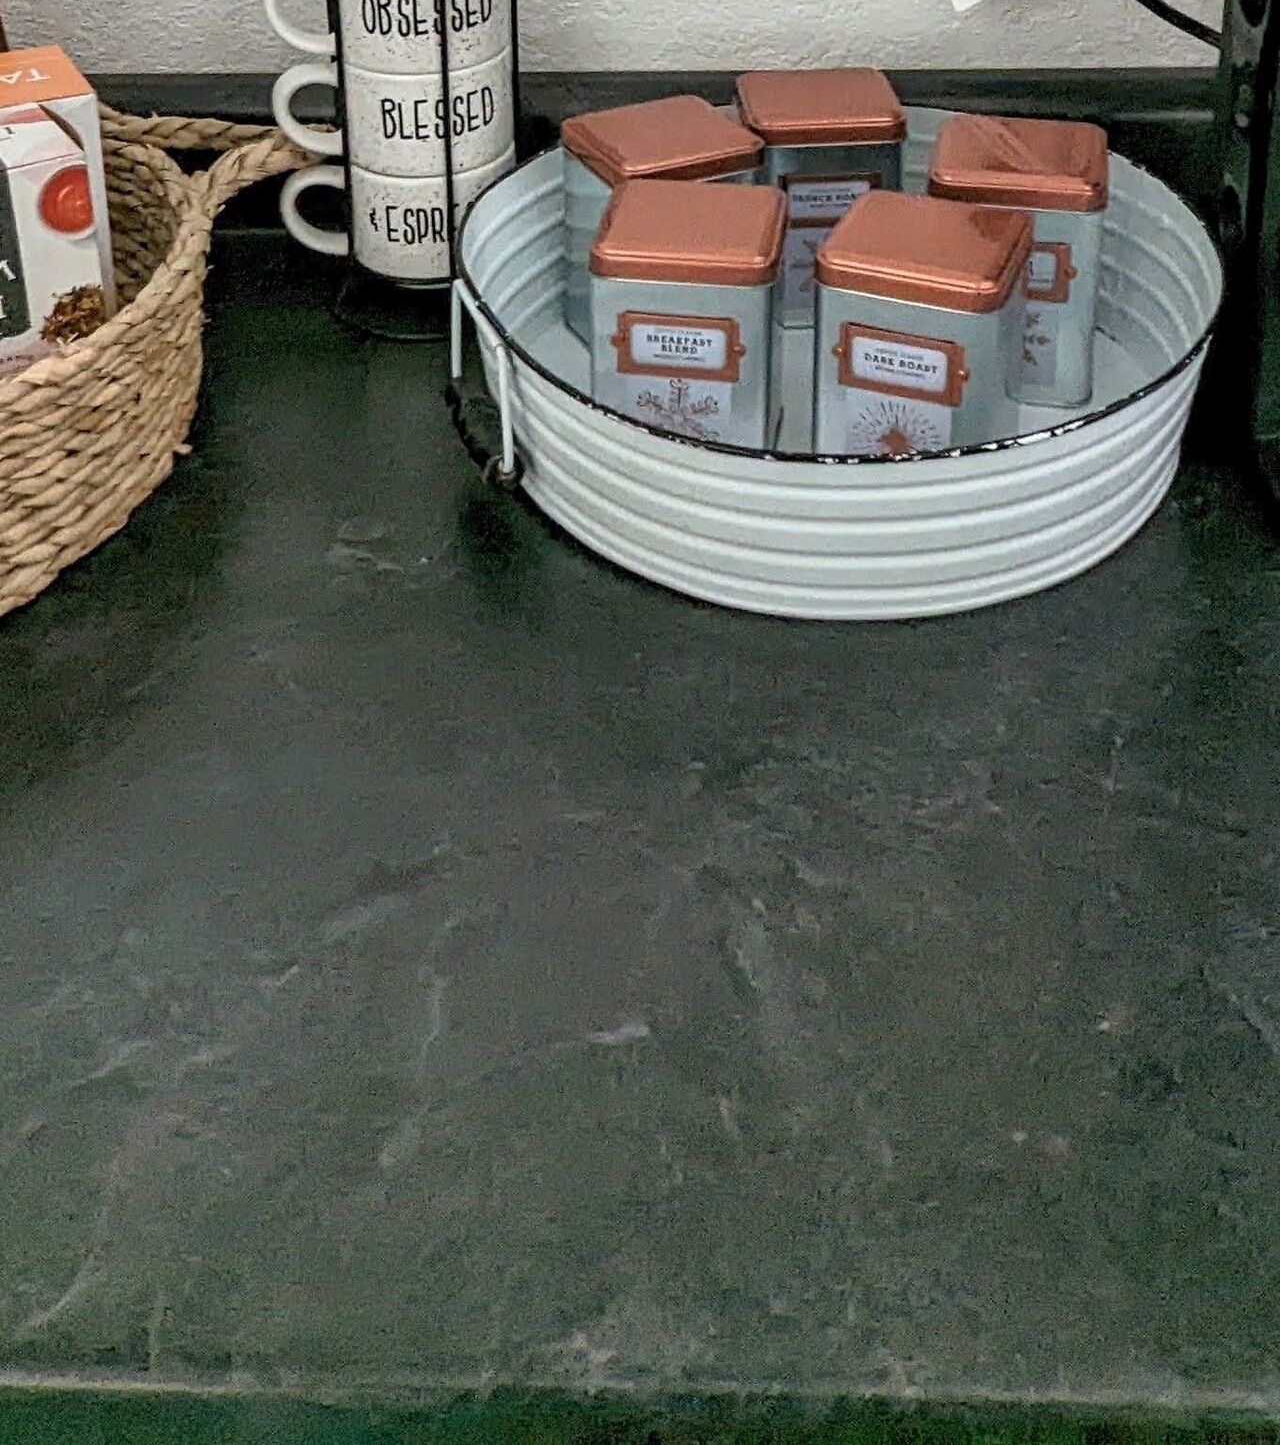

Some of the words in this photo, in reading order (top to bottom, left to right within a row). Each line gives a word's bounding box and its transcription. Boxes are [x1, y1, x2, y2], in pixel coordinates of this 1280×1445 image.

[380, 85, 495, 141] BLESSED
[646, 334, 713, 347] BREAKFAST
[661, 344, 699, 355] BLEND
[863, 352, 895, 366] DARK
[899, 359, 938, 374] ROAST
